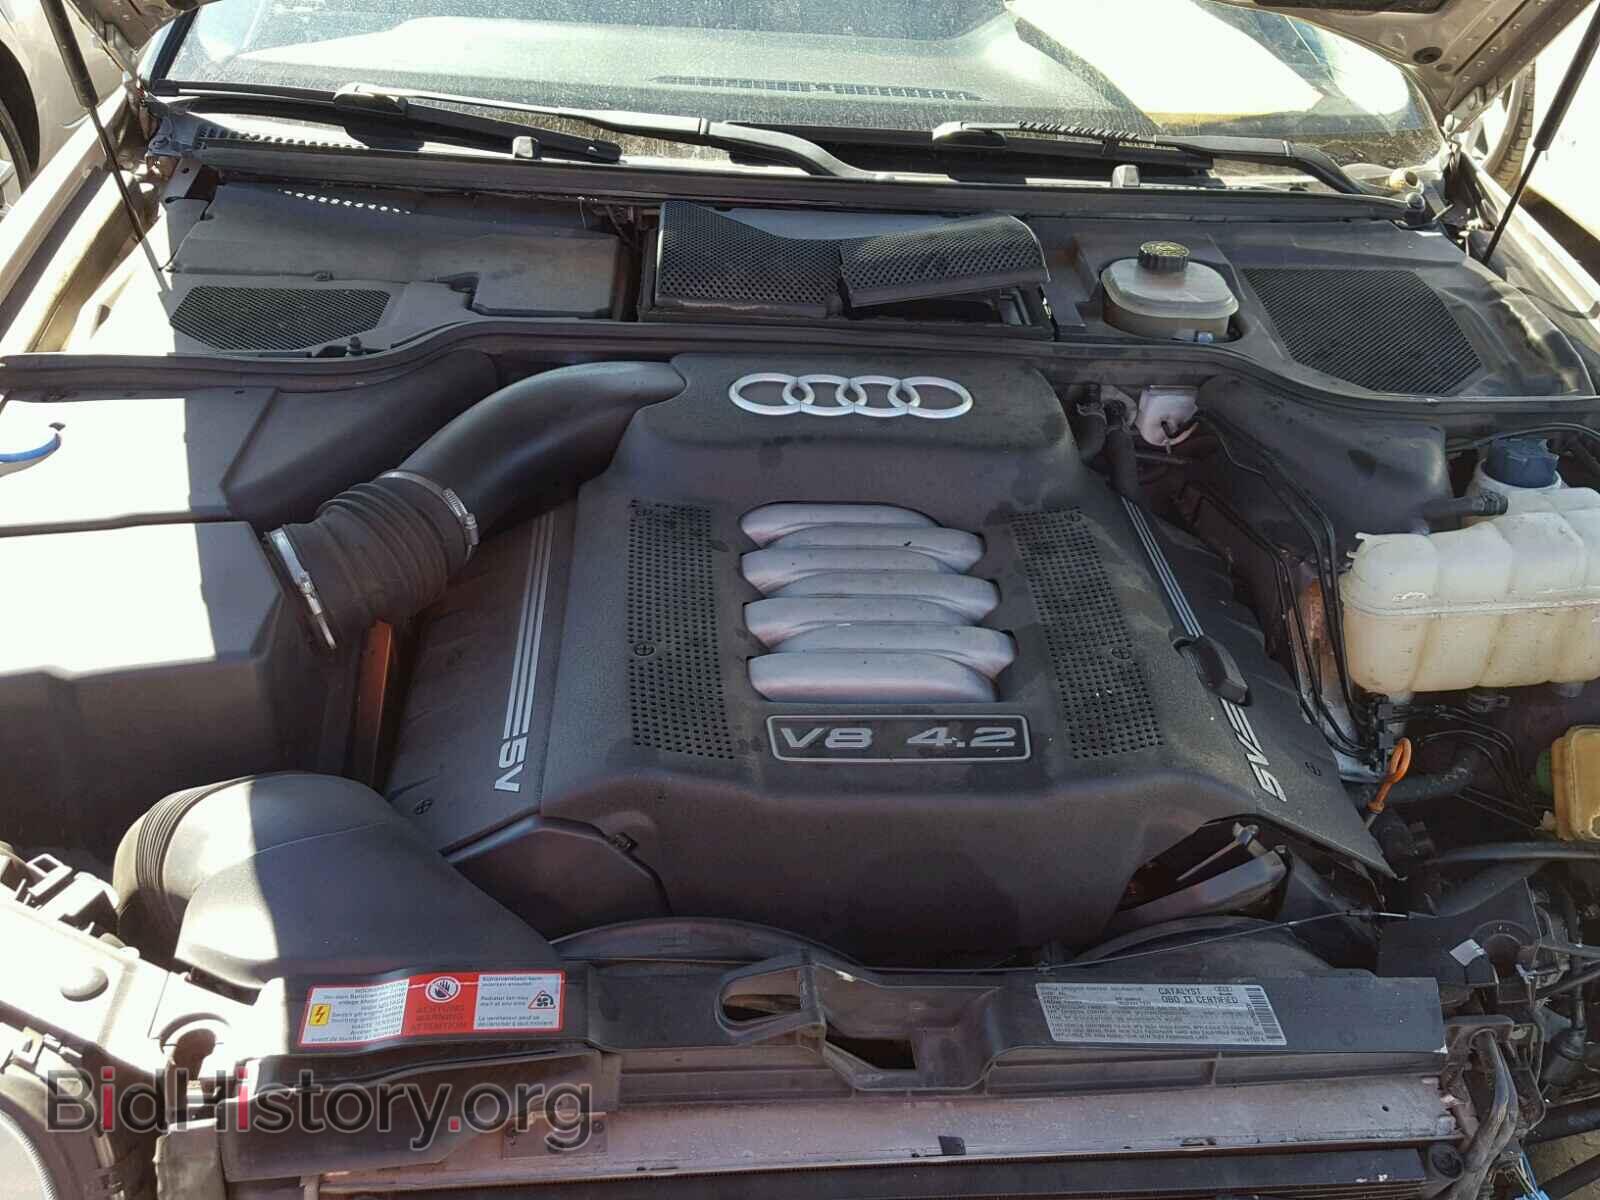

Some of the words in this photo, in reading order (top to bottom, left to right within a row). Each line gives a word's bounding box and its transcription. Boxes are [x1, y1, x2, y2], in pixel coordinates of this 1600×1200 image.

[780, 727, 873, 748] V8
[906, 727, 1018, 748] 4.2
[1158, 987, 1201, 995] CATALYST
[1196, 996, 1239, 1004] CERTIFIED
